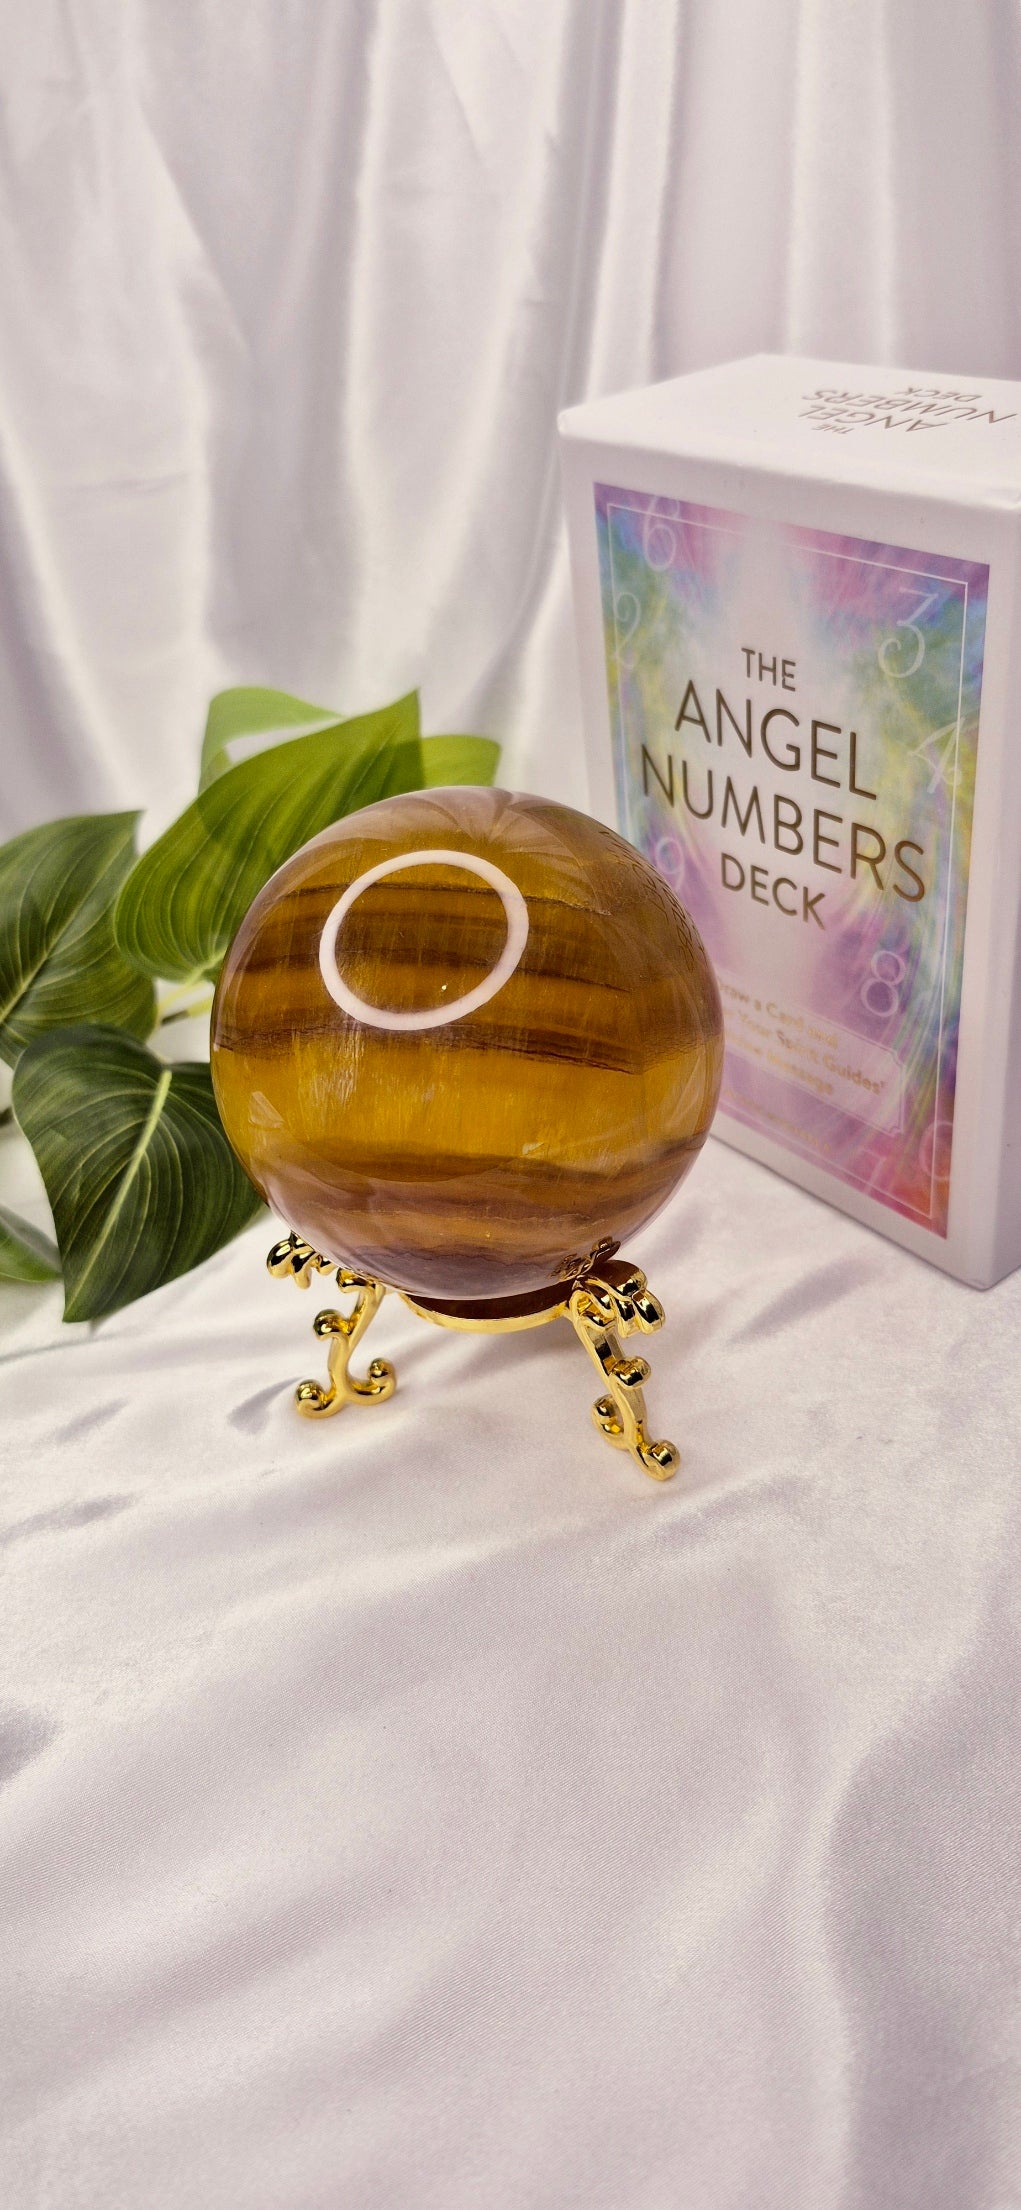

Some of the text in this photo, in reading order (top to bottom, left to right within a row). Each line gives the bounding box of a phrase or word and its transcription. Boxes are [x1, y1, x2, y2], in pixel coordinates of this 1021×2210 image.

[798, 404, 949, 433] ANGEL
[801, 389, 1019, 424] NUMBERS
[894, 386, 983, 403] DECK
[810, 423, 856, 435] THE
[643, 496, 680, 572] 6
[877, 586, 938, 679] 3
[740, 646, 797, 692] THE
[674, 678, 877, 800] ANGEL
[640, 743, 926, 903] NUMBERS
[654, 836, 685, 895] 9
[720, 851, 827, 931] DECK
[860, 950, 906, 1018] 8
